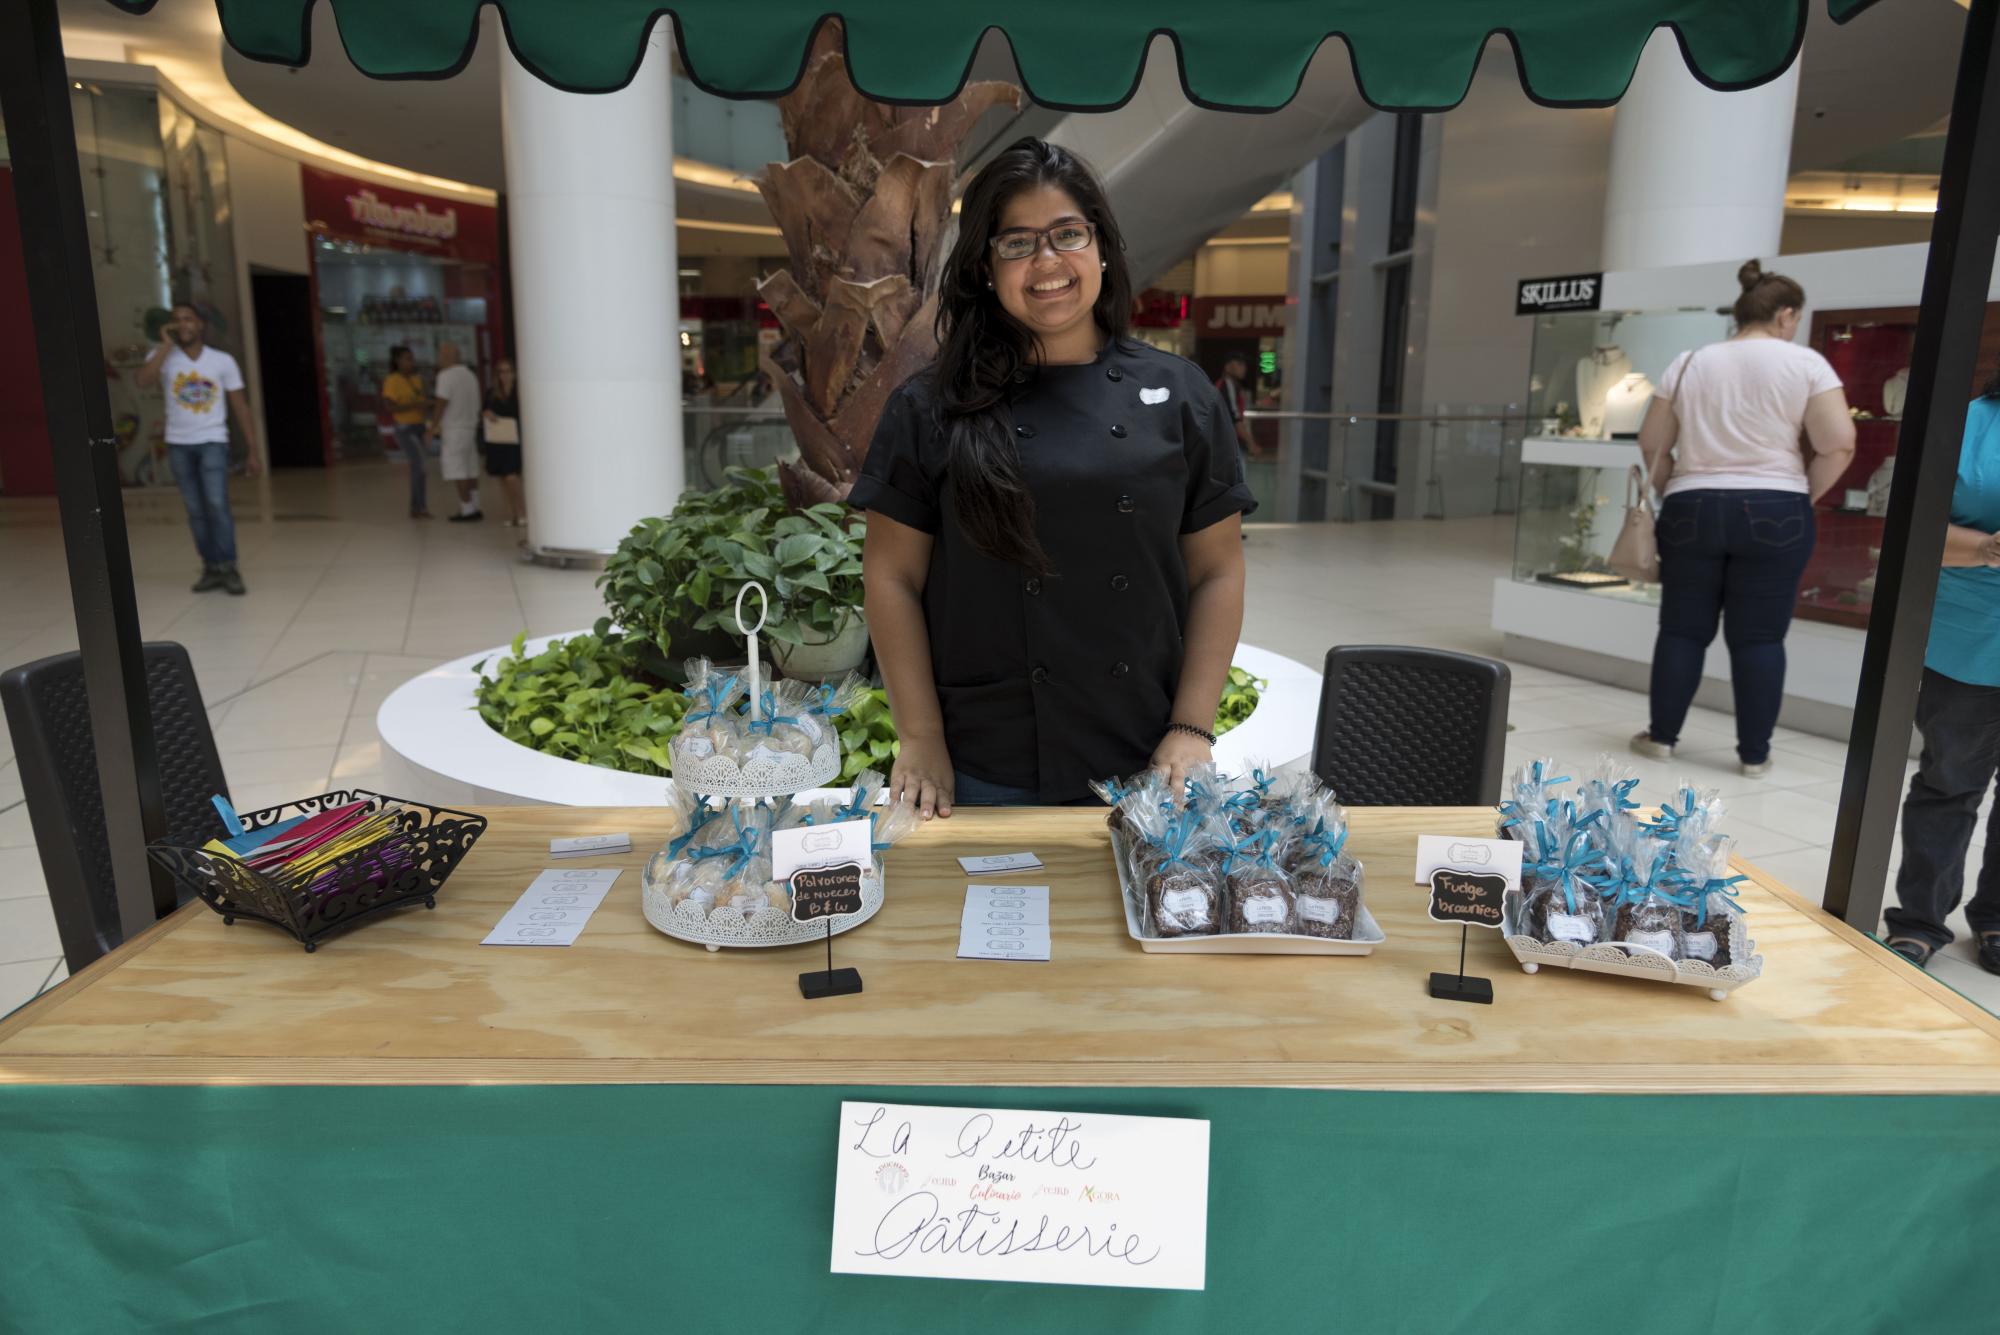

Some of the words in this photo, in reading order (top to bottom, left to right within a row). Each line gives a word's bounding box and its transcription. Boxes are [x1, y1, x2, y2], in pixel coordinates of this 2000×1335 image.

[1520, 279, 1597, 306] SKILLUS
[797, 875, 858, 888] Polvorones
[1438, 876, 1488, 900] Fudge
[796, 891, 811, 902] de
[809, 903, 820, 914] B
[1438, 897, 1500, 918] brownies
[945, 1113, 1097, 1170] Petite
[978, 1164, 1016, 1184] Bazar
[969, 1183, 1022, 1201] Culinario
[855, 1191, 1161, 1265] Pâtisserie
